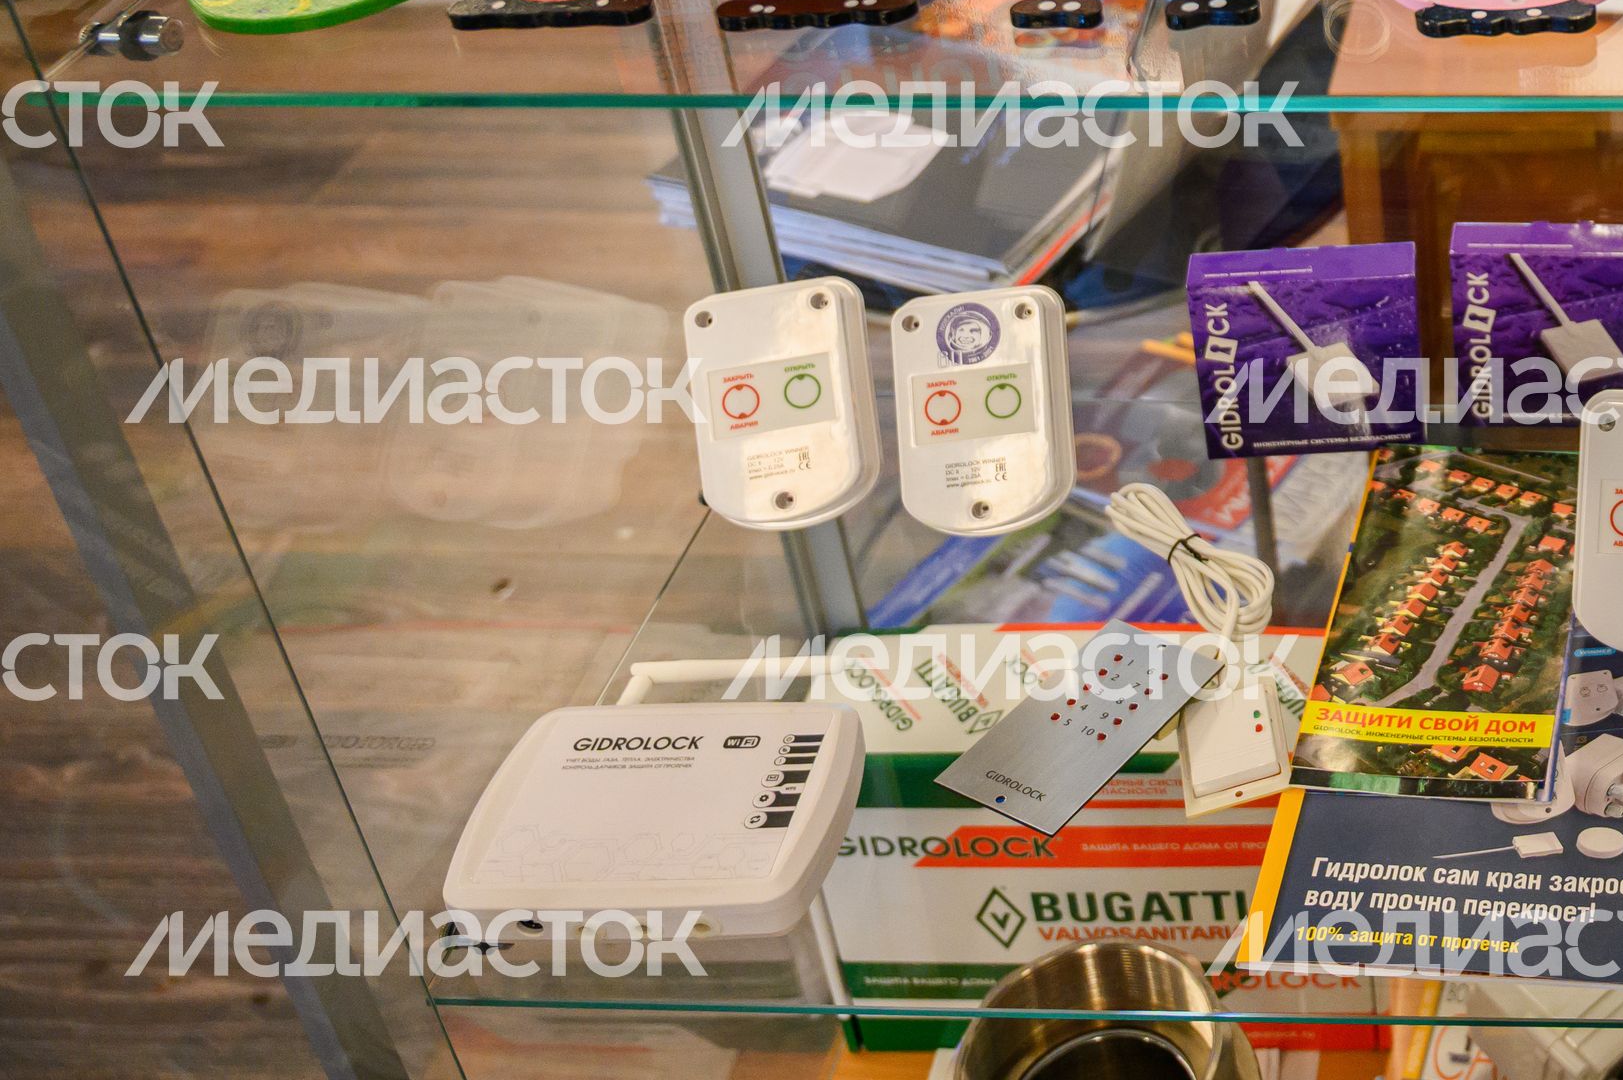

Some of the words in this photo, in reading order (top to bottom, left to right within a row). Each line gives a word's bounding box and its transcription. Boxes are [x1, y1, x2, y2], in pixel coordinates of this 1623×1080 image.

[987, 373, 1017, 382] ОТКРЫТЬ
[927, 380, 957, 389] ЗАКРЫТЬ
[931, 428, 959, 436] АВАРИЯ
[1253, 438, 1308, 448] ИНЖЕНЕРНЫЕ
[1310, 435, 1348, 445] СИСТЕМЫ
[1127, 658, 1135, 666] 1
[1111, 673, 1120, 682] 2
[1132, 681, 1141, 689] 7
[1115, 697, 1124, 705] 8
[1080, 703, 1089, 711] 4
[1063, 718, 1072, 727] 5
[1316, 708, 1412, 728] ЗАЩИТИ
[1419, 715, 1478, 732] СВОЙ
[1484, 720, 1536, 735] ДОМ
[1080, 725, 1096, 736] 10
[1366, 731, 1424, 740] ИНЖЕНЕРНЫЕ
[573, 736, 704, 751] GIDROLOCK
[985, 770, 1046, 802] GIDROLOCK
[838, 835, 1058, 859] GIDROLOCK
[1311, 857, 1427, 883] Гидролок
[1433, 867, 1480, 886] сам
[1486, 871, 1542, 892] кран
[1031, 891, 1246, 922] BUGATTI
[1305, 889, 1364, 912] воду
[1369, 892, 1456, 914] прочно
[1463, 897, 1596, 924] перекроет!
[1296, 926, 1344, 942] 100%
[1349, 929, 1413, 947] защита
[1418, 933, 1437, 947] от
[1441, 936, 1519, 953] протечек
